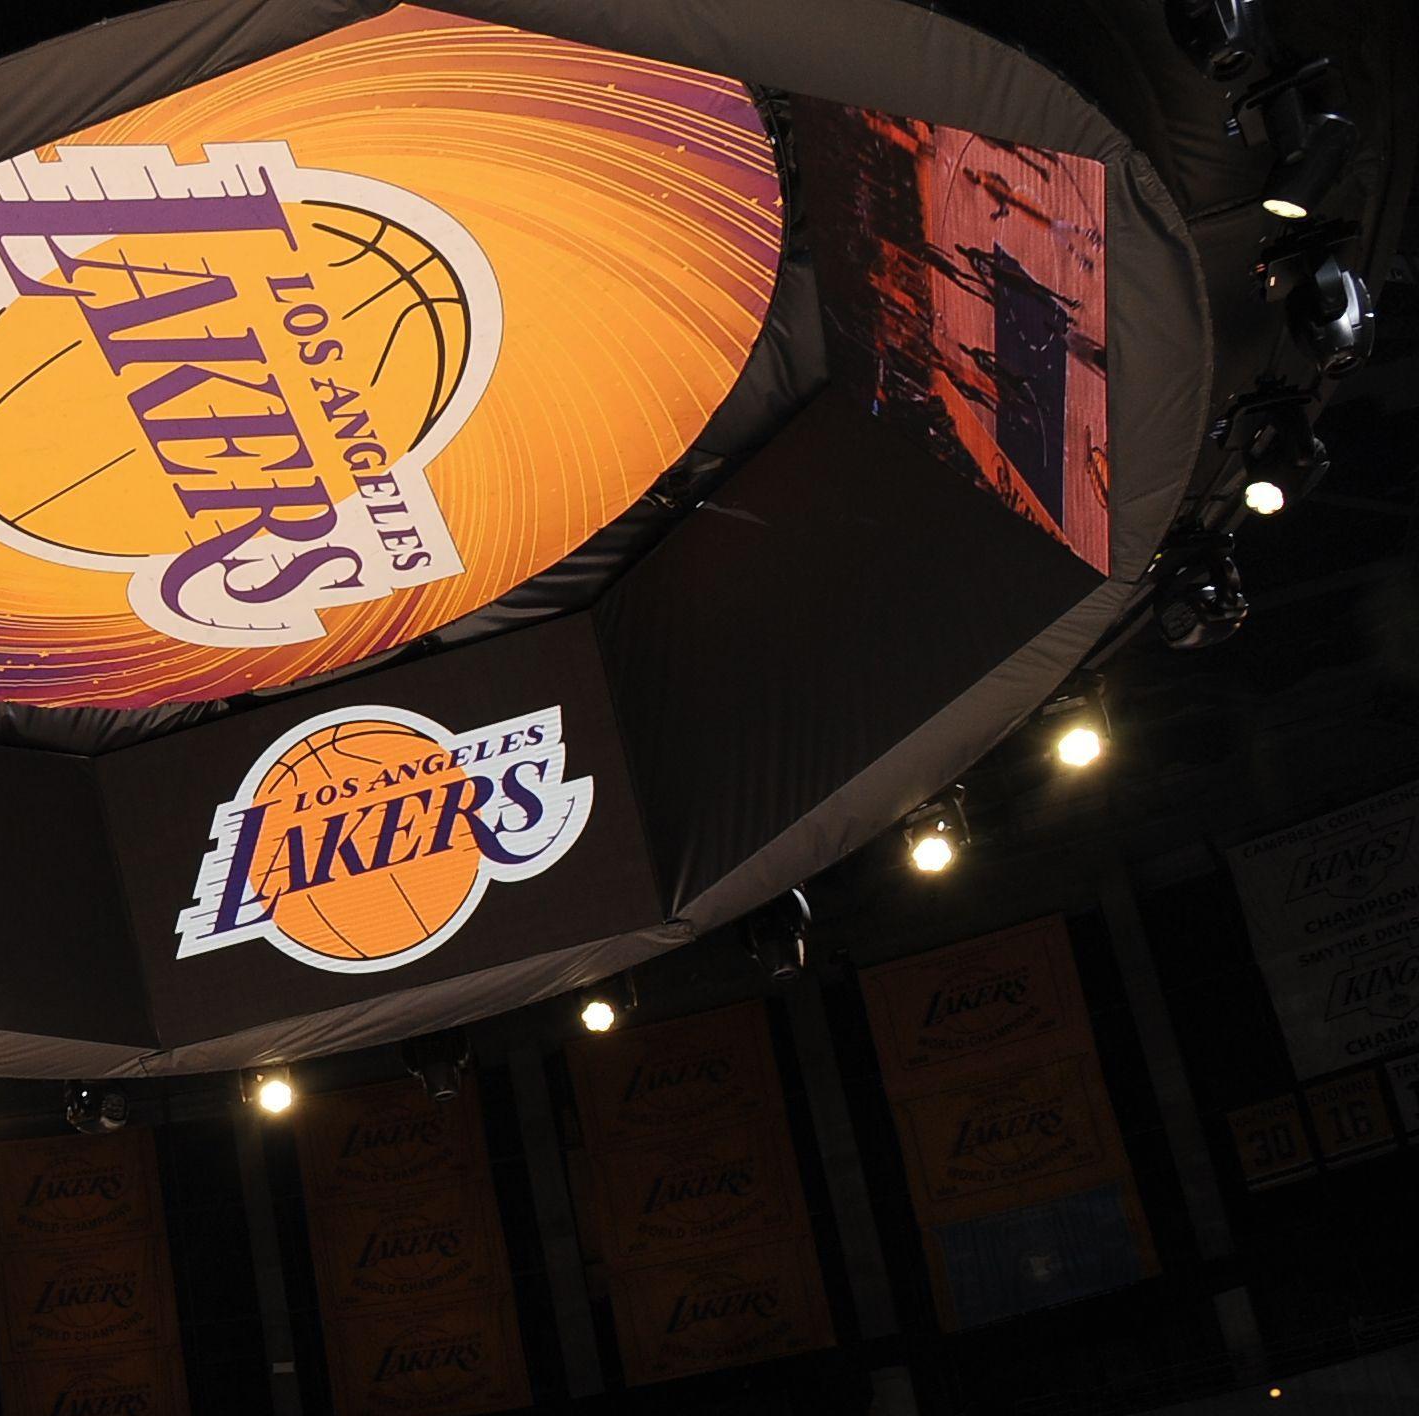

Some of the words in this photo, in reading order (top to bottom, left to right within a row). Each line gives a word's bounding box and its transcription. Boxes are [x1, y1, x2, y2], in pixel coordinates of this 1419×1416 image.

[265, 273, 344, 366] LOS
[309, 375, 432, 573] ANGELES
[293, 777, 360, 814] LOS
[366, 724, 545, 793] ANGELES
[197, 759, 575, 940] LAKERS
[1303, 831, 1400, 890] KINGS
[1303, 885, 1419, 935] CHAMPION
[1342, 957, 1419, 1007] KING
